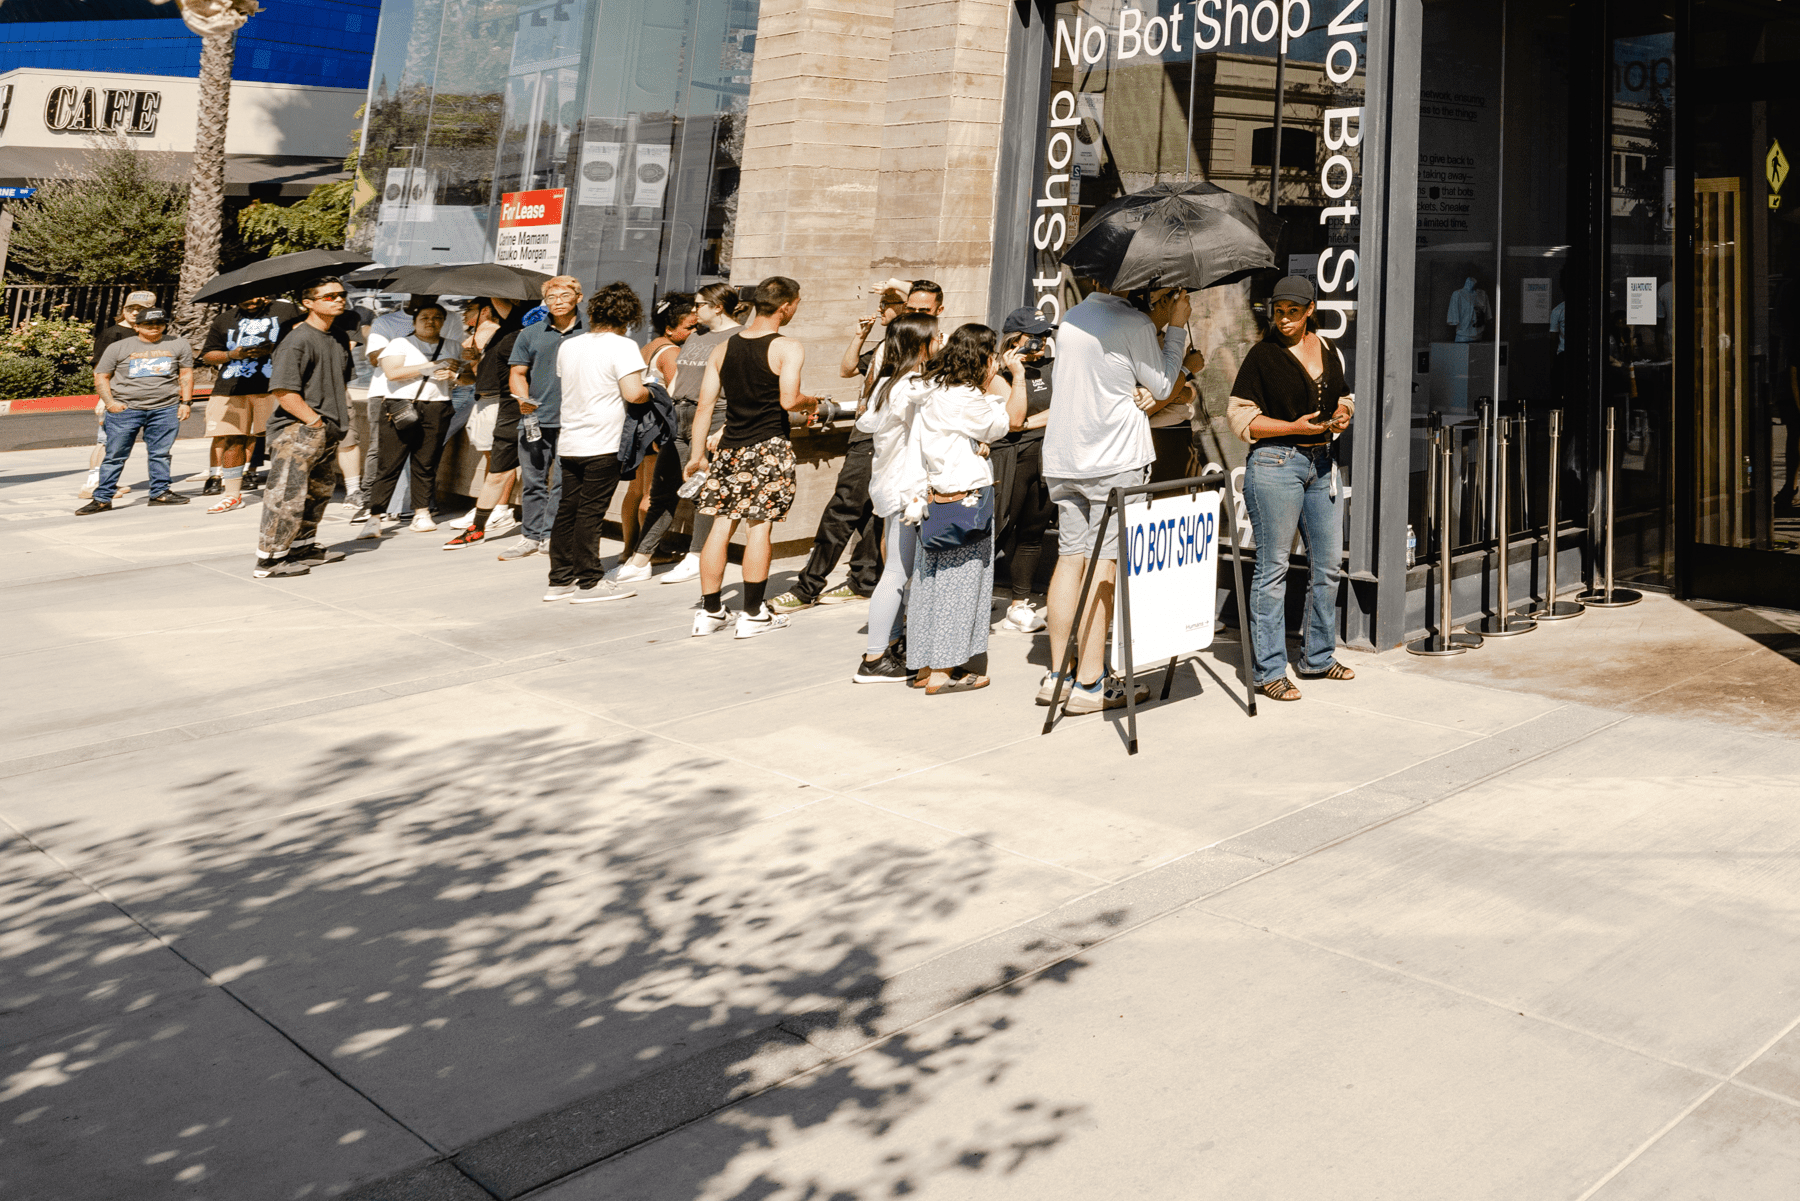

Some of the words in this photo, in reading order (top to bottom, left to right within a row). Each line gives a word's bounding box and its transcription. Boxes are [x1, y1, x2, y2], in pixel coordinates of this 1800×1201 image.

[1053, 16, 1106, 69] No
[1117, 2, 1184, 61] Bot
[44, 84, 162, 135] CAFE
[1032, 89, 1081, 252] Shop
[1319, 106, 1364, 225] Bot
[502, 202, 516, 221] For
[515, 201, 546, 220] Lease
[518, 231, 549, 246] Mamann
[519, 246, 547, 263] Morgan
[1316, 247, 1360, 377] Sh
[1125, 523, 1145, 577] NO
[1147, 519, 1175, 573] BOT
[1177, 512, 1214, 567] SHOP
[1185, 622, 1204, 631] Humans
